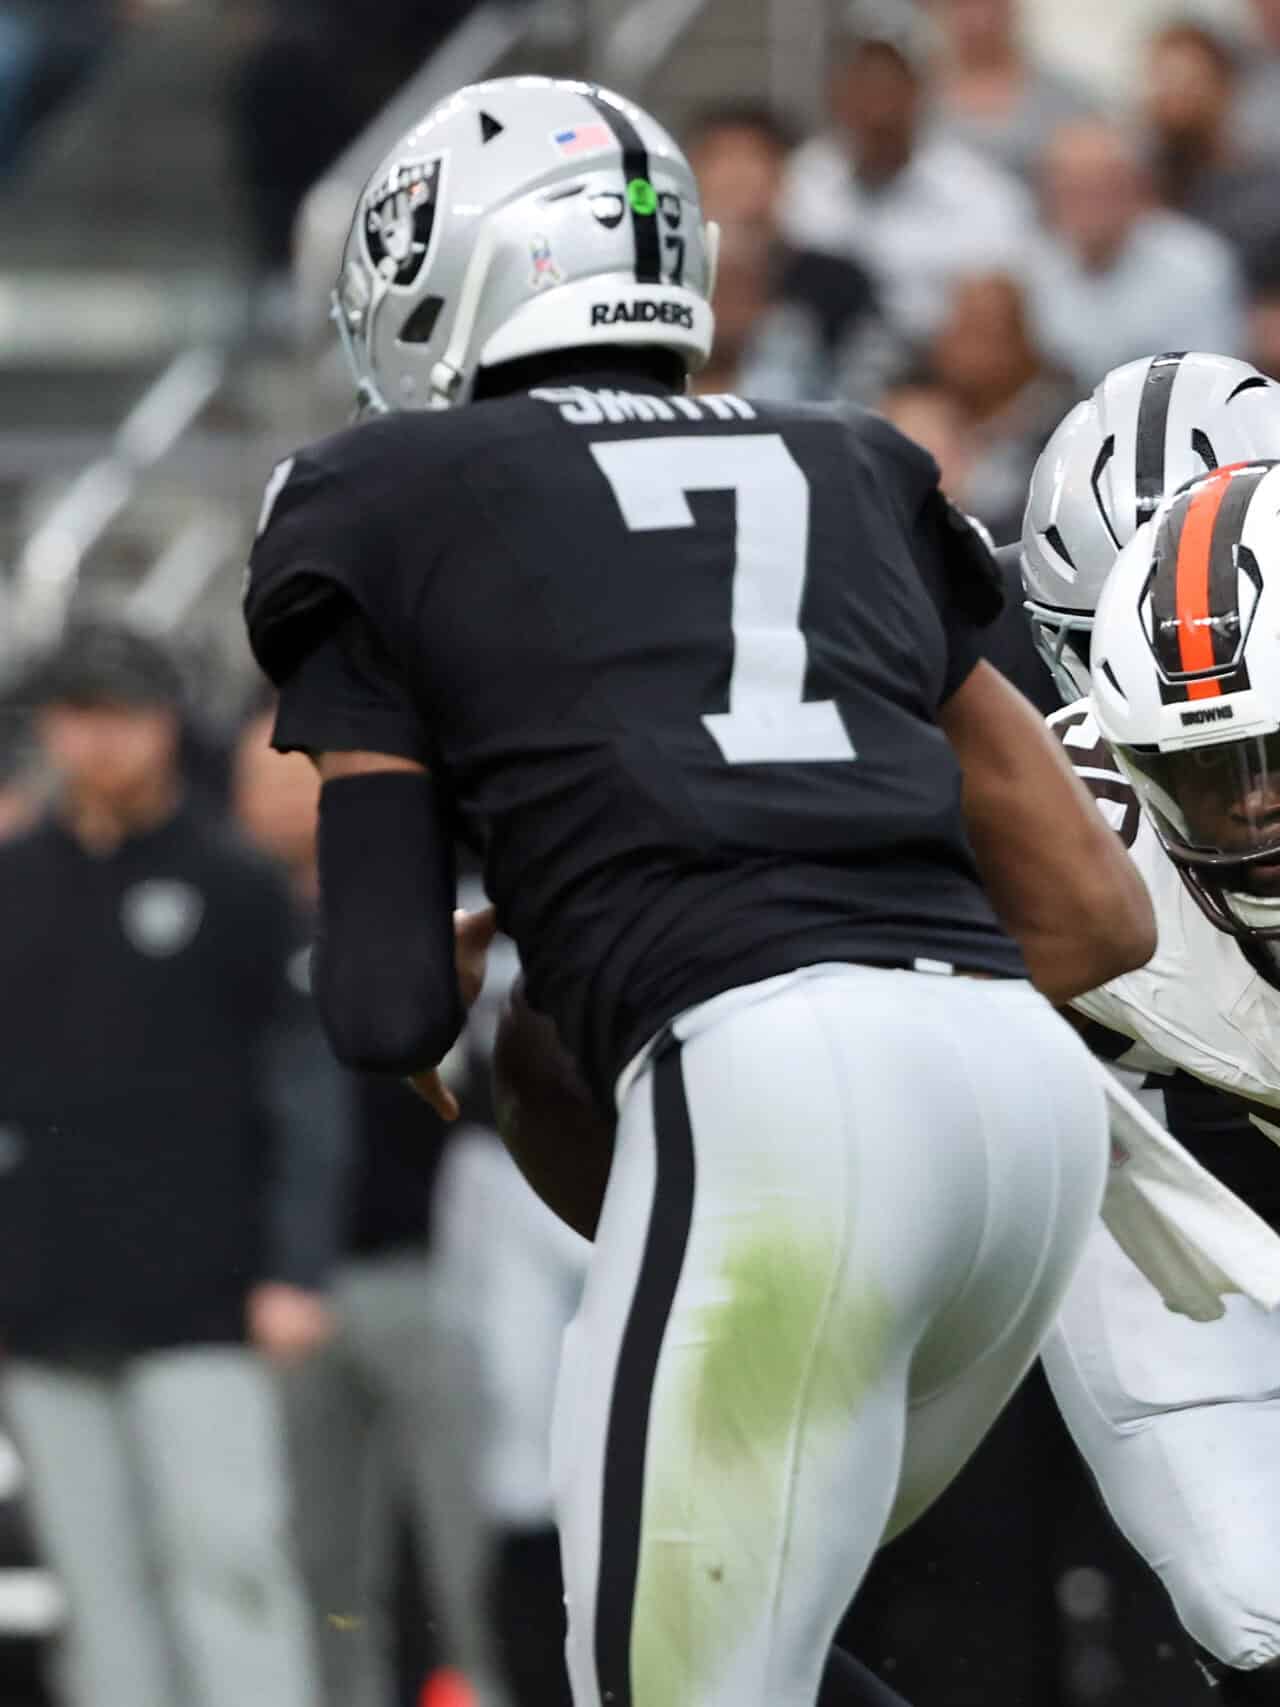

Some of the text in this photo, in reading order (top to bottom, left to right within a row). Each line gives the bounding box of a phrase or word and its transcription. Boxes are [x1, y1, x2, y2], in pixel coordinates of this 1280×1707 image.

[590, 300, 694, 330] RAIDERS
[590, 433, 857, 765] 7
[1180, 704, 1233, 727] BROWNS
